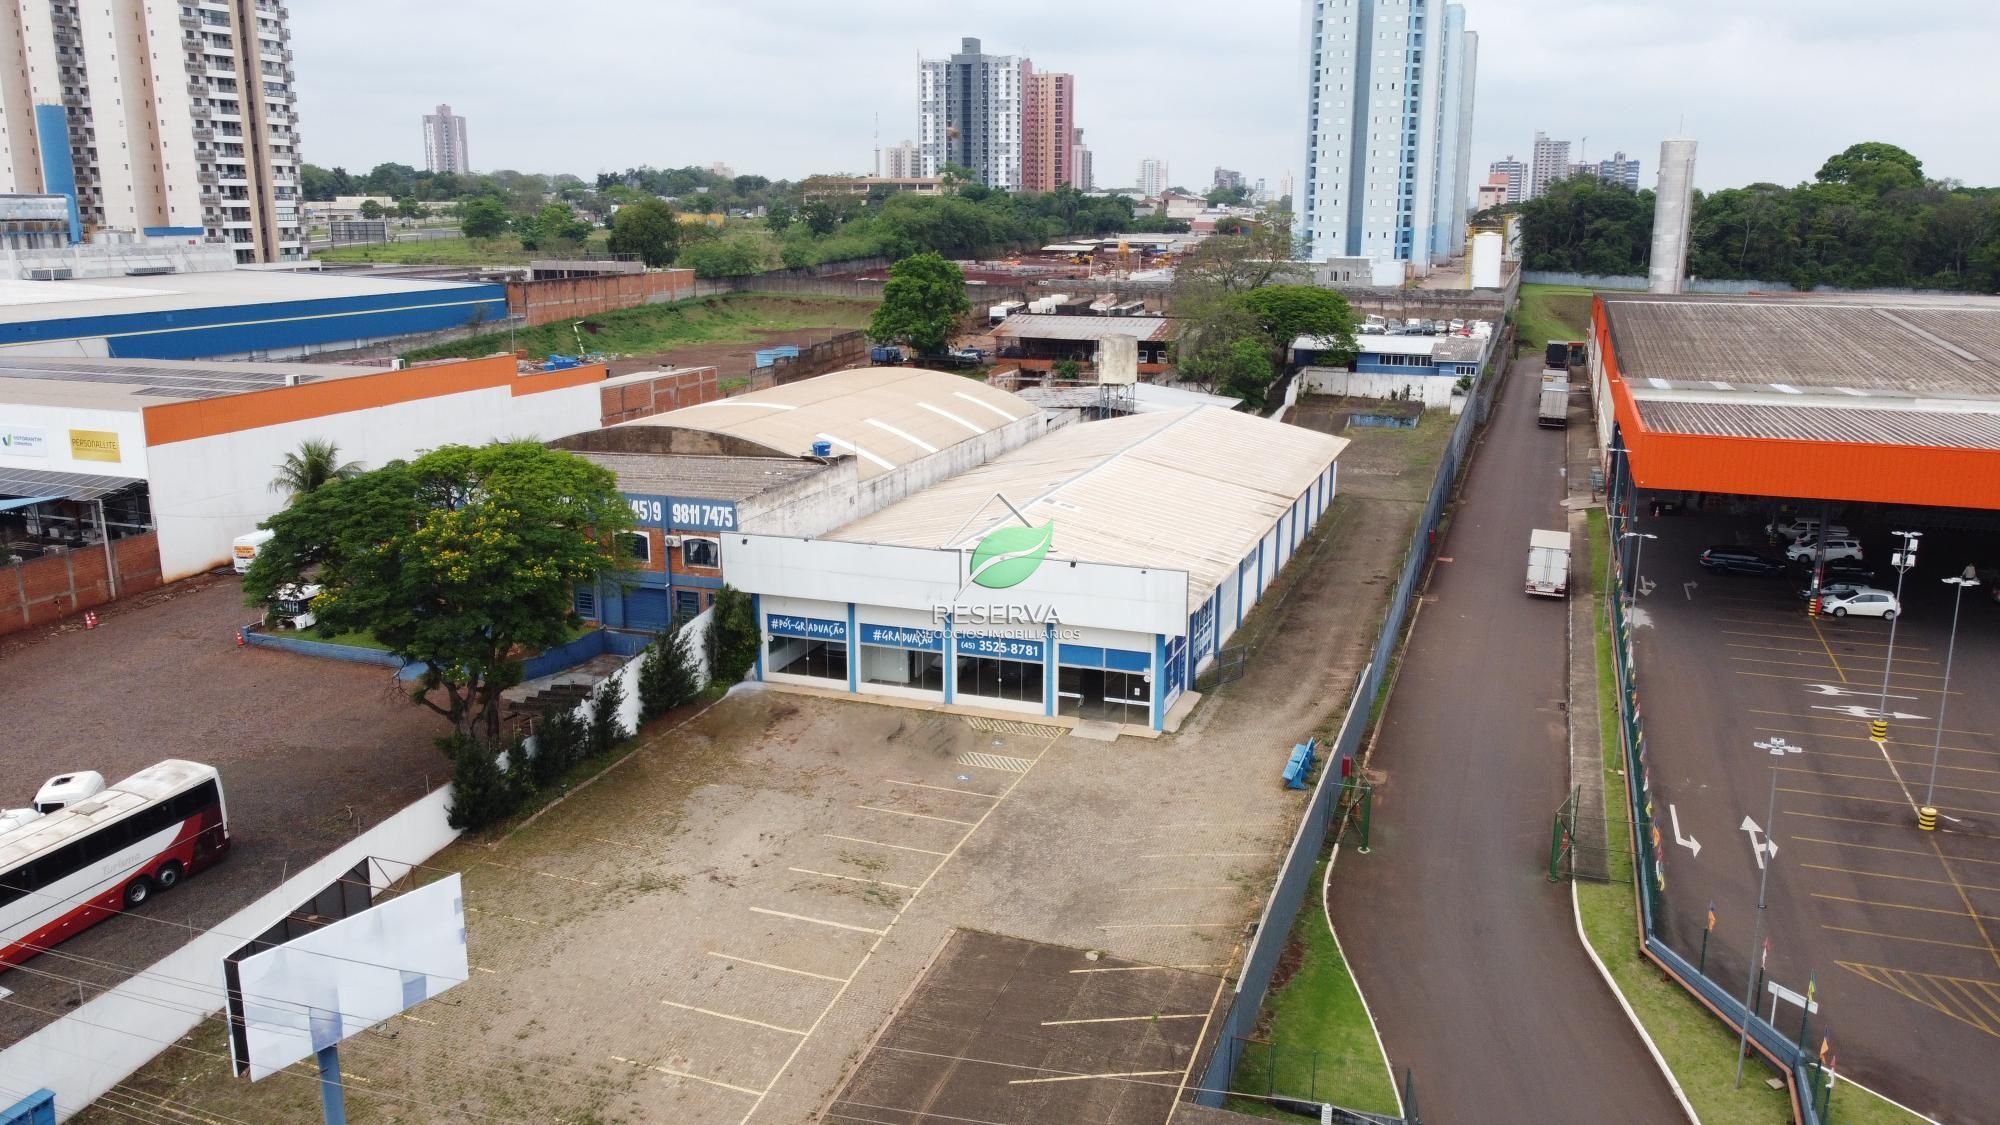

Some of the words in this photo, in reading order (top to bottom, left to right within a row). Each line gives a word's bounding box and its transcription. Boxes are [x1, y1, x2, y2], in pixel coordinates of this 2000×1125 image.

[672, 503, 700, 525] 9811
[702, 505, 733, 527] 7475
[771, 617, 845, 637] #PÓS-GRADUAÇÃO
[960, 641, 976, 650] (45)
